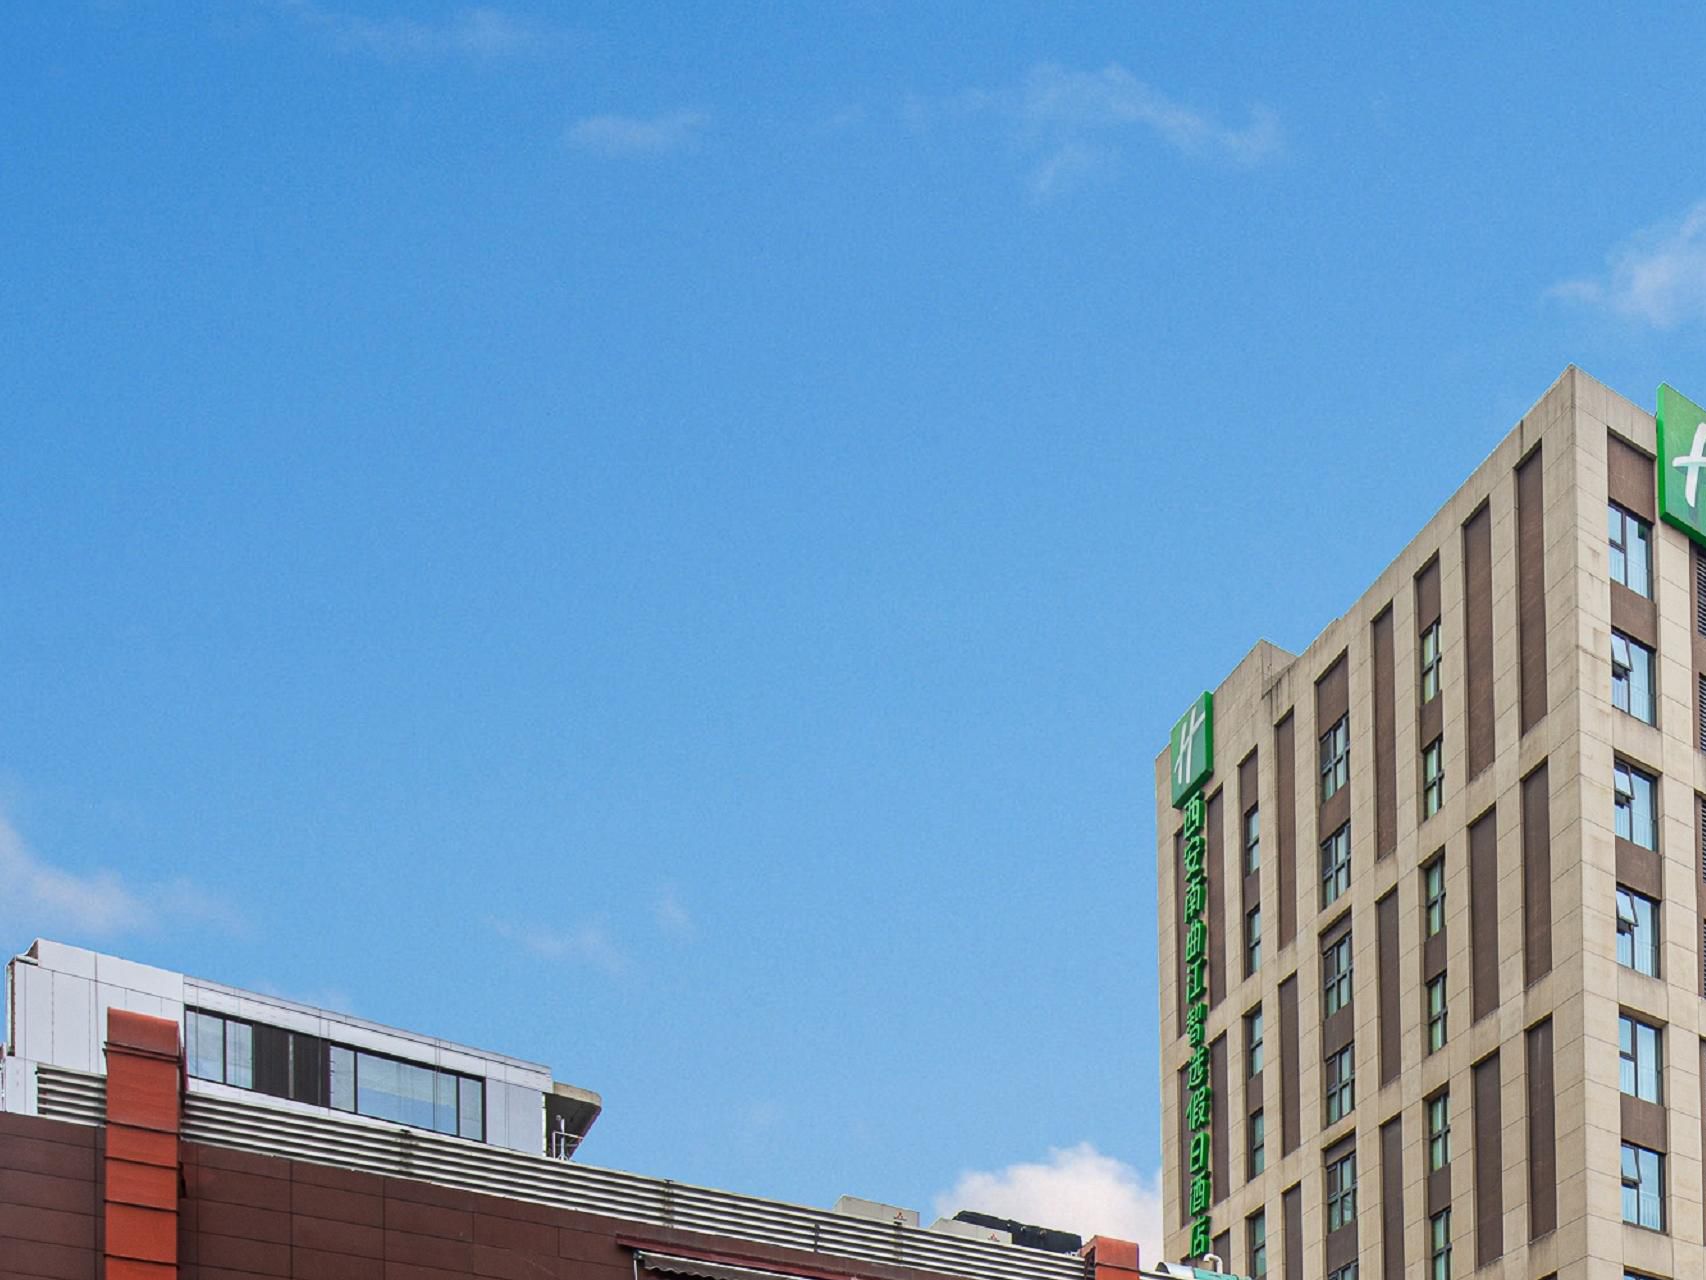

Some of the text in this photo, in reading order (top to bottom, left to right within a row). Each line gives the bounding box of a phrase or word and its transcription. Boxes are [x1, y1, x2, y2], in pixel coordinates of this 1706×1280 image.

[1184, 790, 1210, 1258] 西安南曲江智选假日酒店
